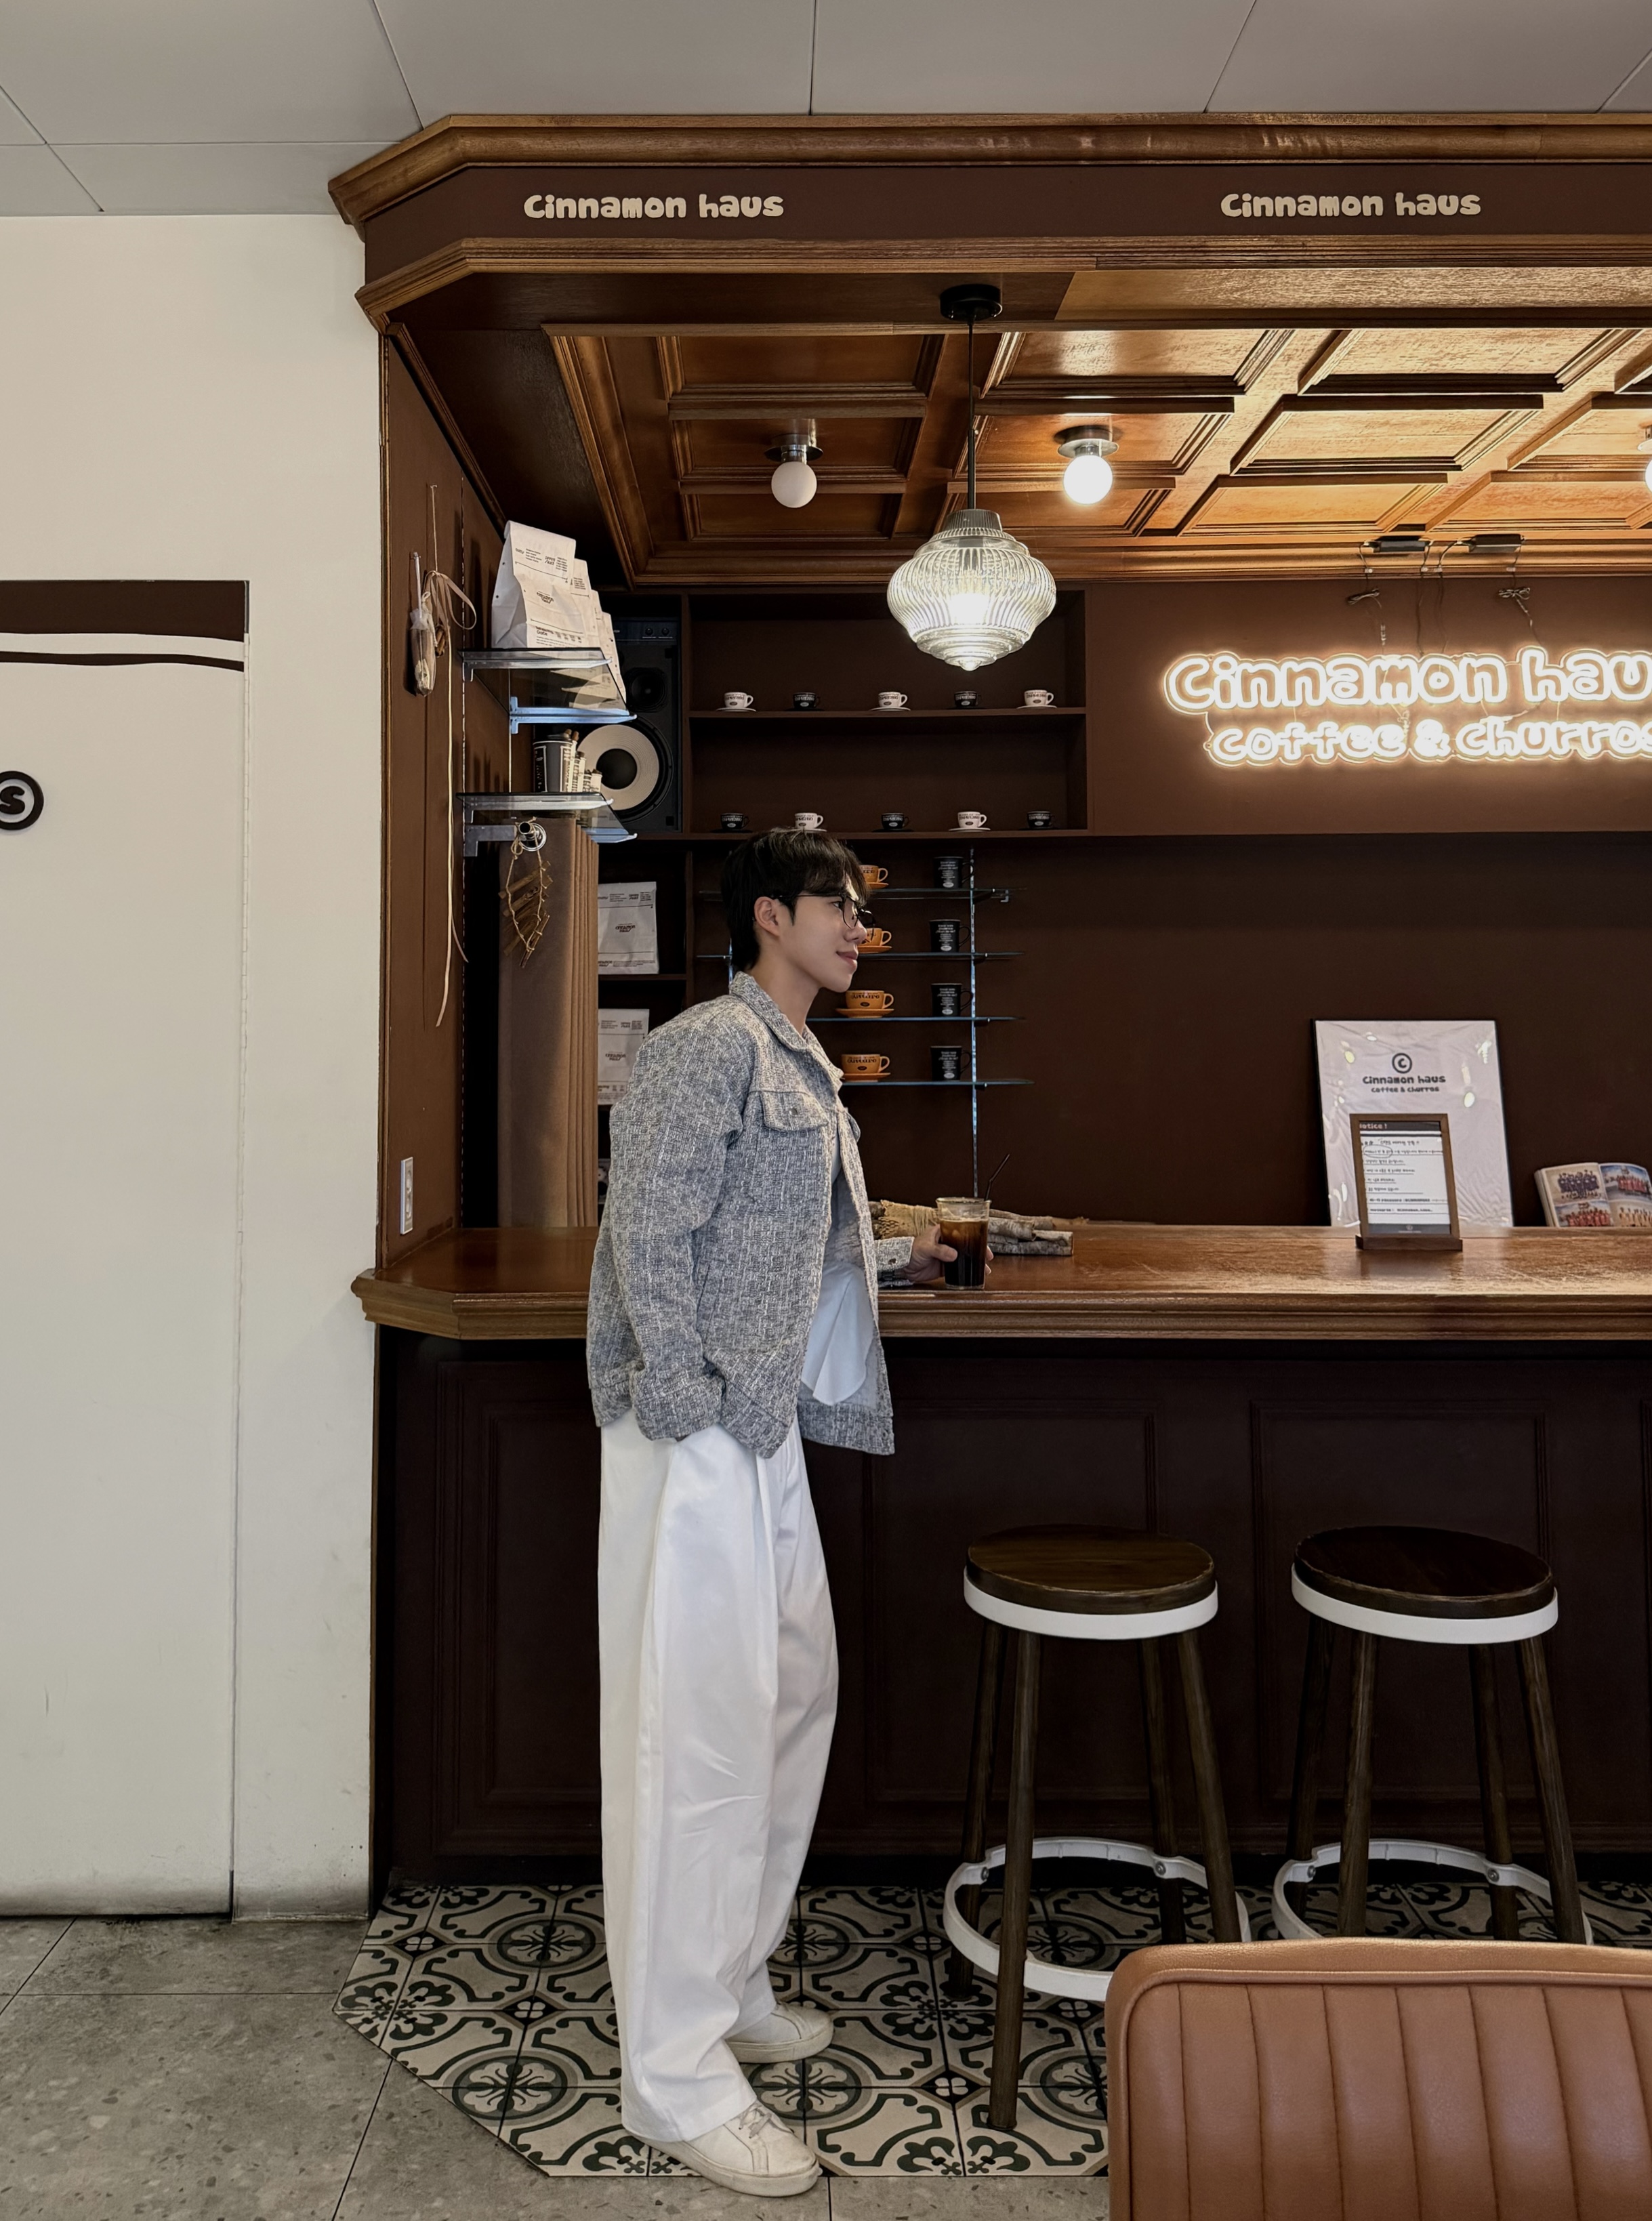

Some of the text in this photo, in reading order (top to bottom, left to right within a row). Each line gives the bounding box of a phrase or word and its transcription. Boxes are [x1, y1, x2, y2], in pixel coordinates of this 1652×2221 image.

[524, 194, 784, 219] Cinnamon haus
[1220, 192, 1481, 217] Cinnamon haus
[1168, 655, 1508, 709] Cinnamon
[1213, 721, 1406, 761] coffee
[1414, 719, 1451, 758] &
[1362, 1075, 1446, 1085] Cinnamon haus
